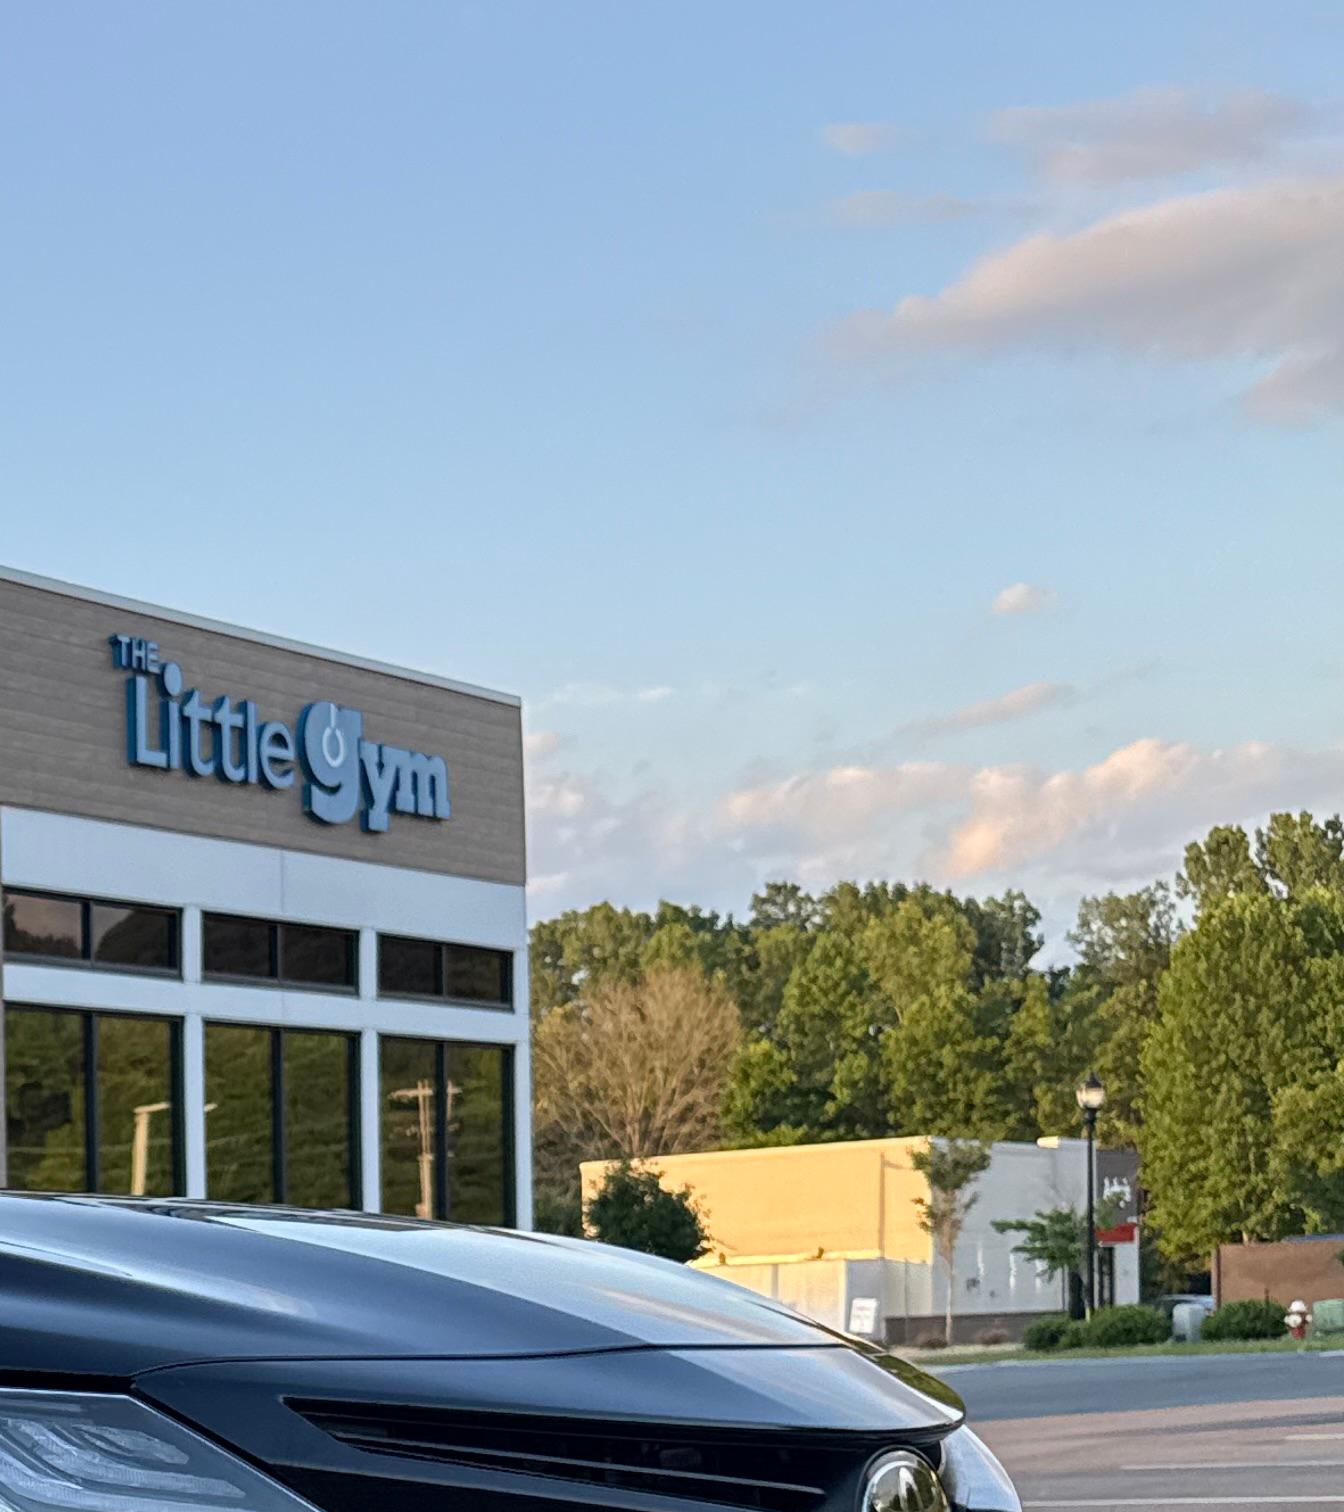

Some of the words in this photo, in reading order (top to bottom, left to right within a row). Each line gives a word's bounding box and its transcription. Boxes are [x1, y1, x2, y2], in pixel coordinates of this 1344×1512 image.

[109, 633, 163, 674] THE
[126, 661, 297, 791] Little
[296, 699, 453, 833] gym
